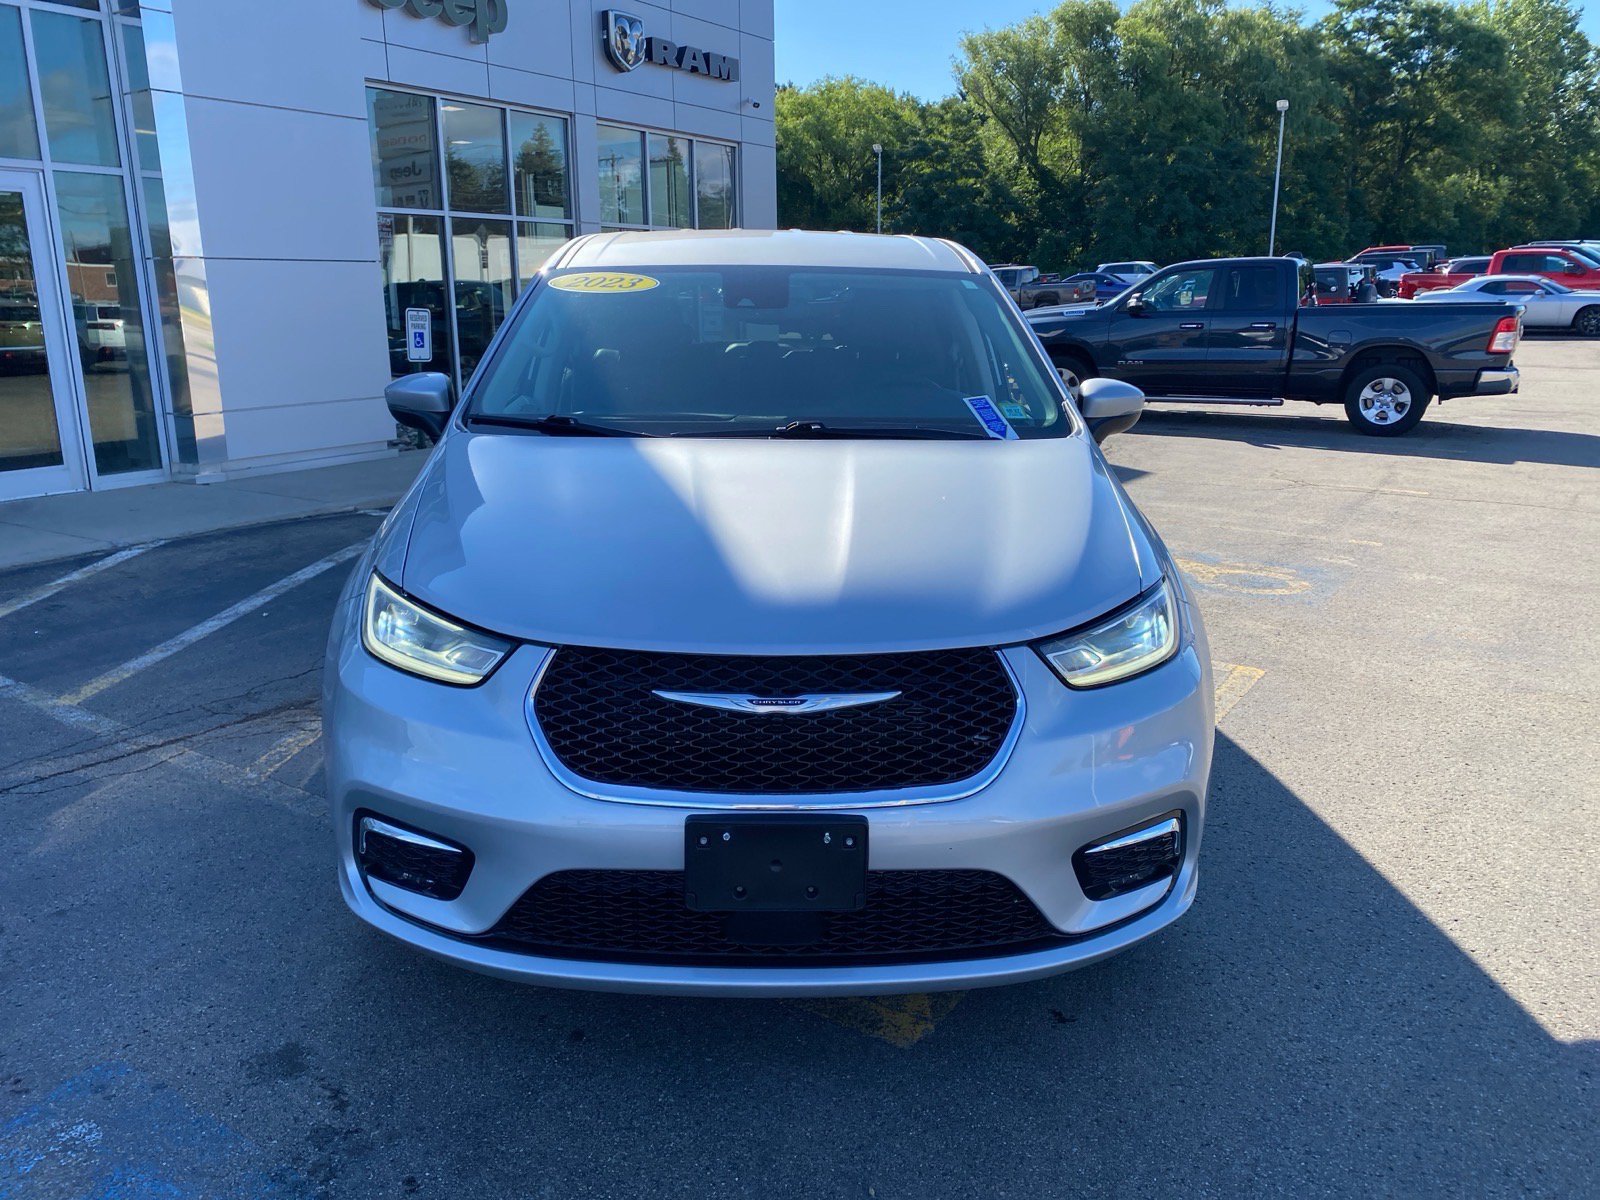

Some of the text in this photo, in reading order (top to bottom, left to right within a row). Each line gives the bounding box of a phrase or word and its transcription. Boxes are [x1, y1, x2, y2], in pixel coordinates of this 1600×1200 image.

[365, 0, 508, 44] ep
[647, 37, 739, 82] RAM
[565, 276, 643, 288] 2023
